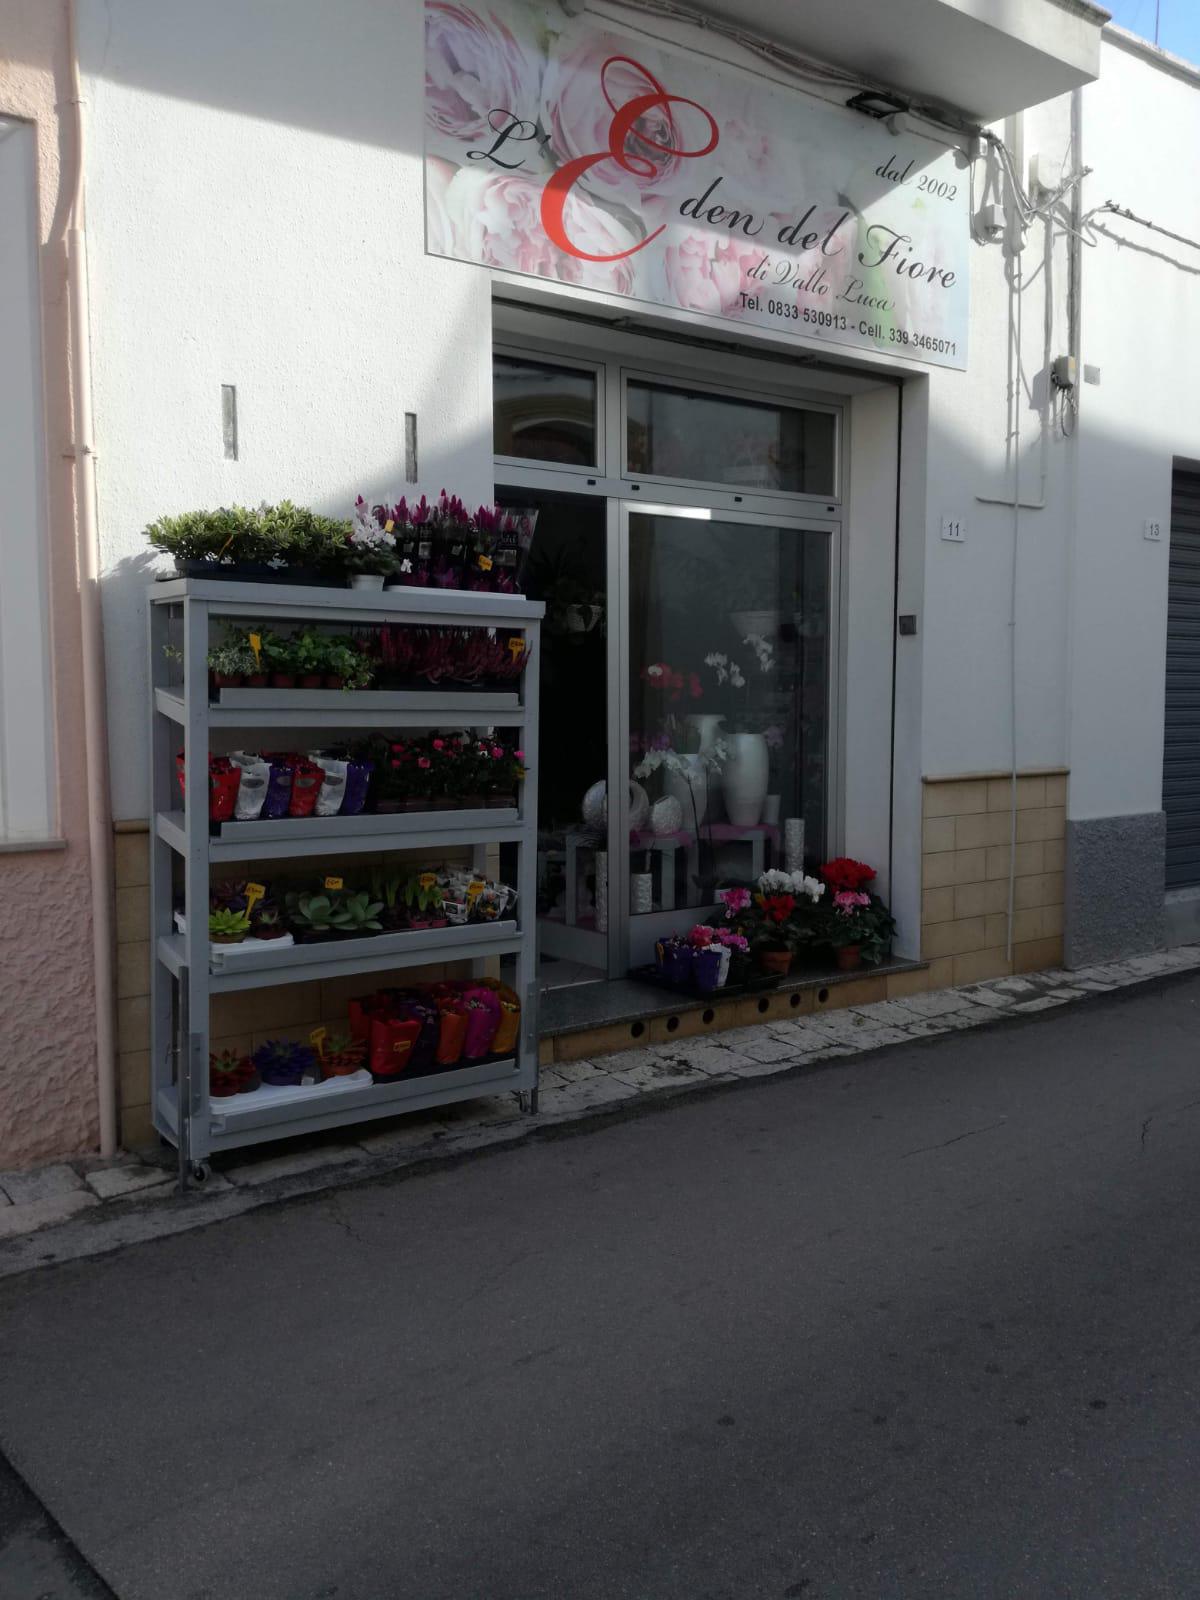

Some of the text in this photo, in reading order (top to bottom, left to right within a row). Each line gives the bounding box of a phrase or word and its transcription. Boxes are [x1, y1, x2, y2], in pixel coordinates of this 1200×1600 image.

[875, 154, 958, 201] dal 2002
[777, 205, 849, 257] del
[858, 224, 957, 289] Fiore
[746, 255, 771, 281] di
[835, 275, 896, 312] Luca
[740, 292, 763, 313] Tel.
[768, 299, 799, 320] 0833
[803, 308, 847, 331] 530913
[859, 320, 885, 340] Cell.
[889, 327, 909, 345] 339
[912, 333, 957, 356] 3465071
[948, 521, 960, 537] 11
